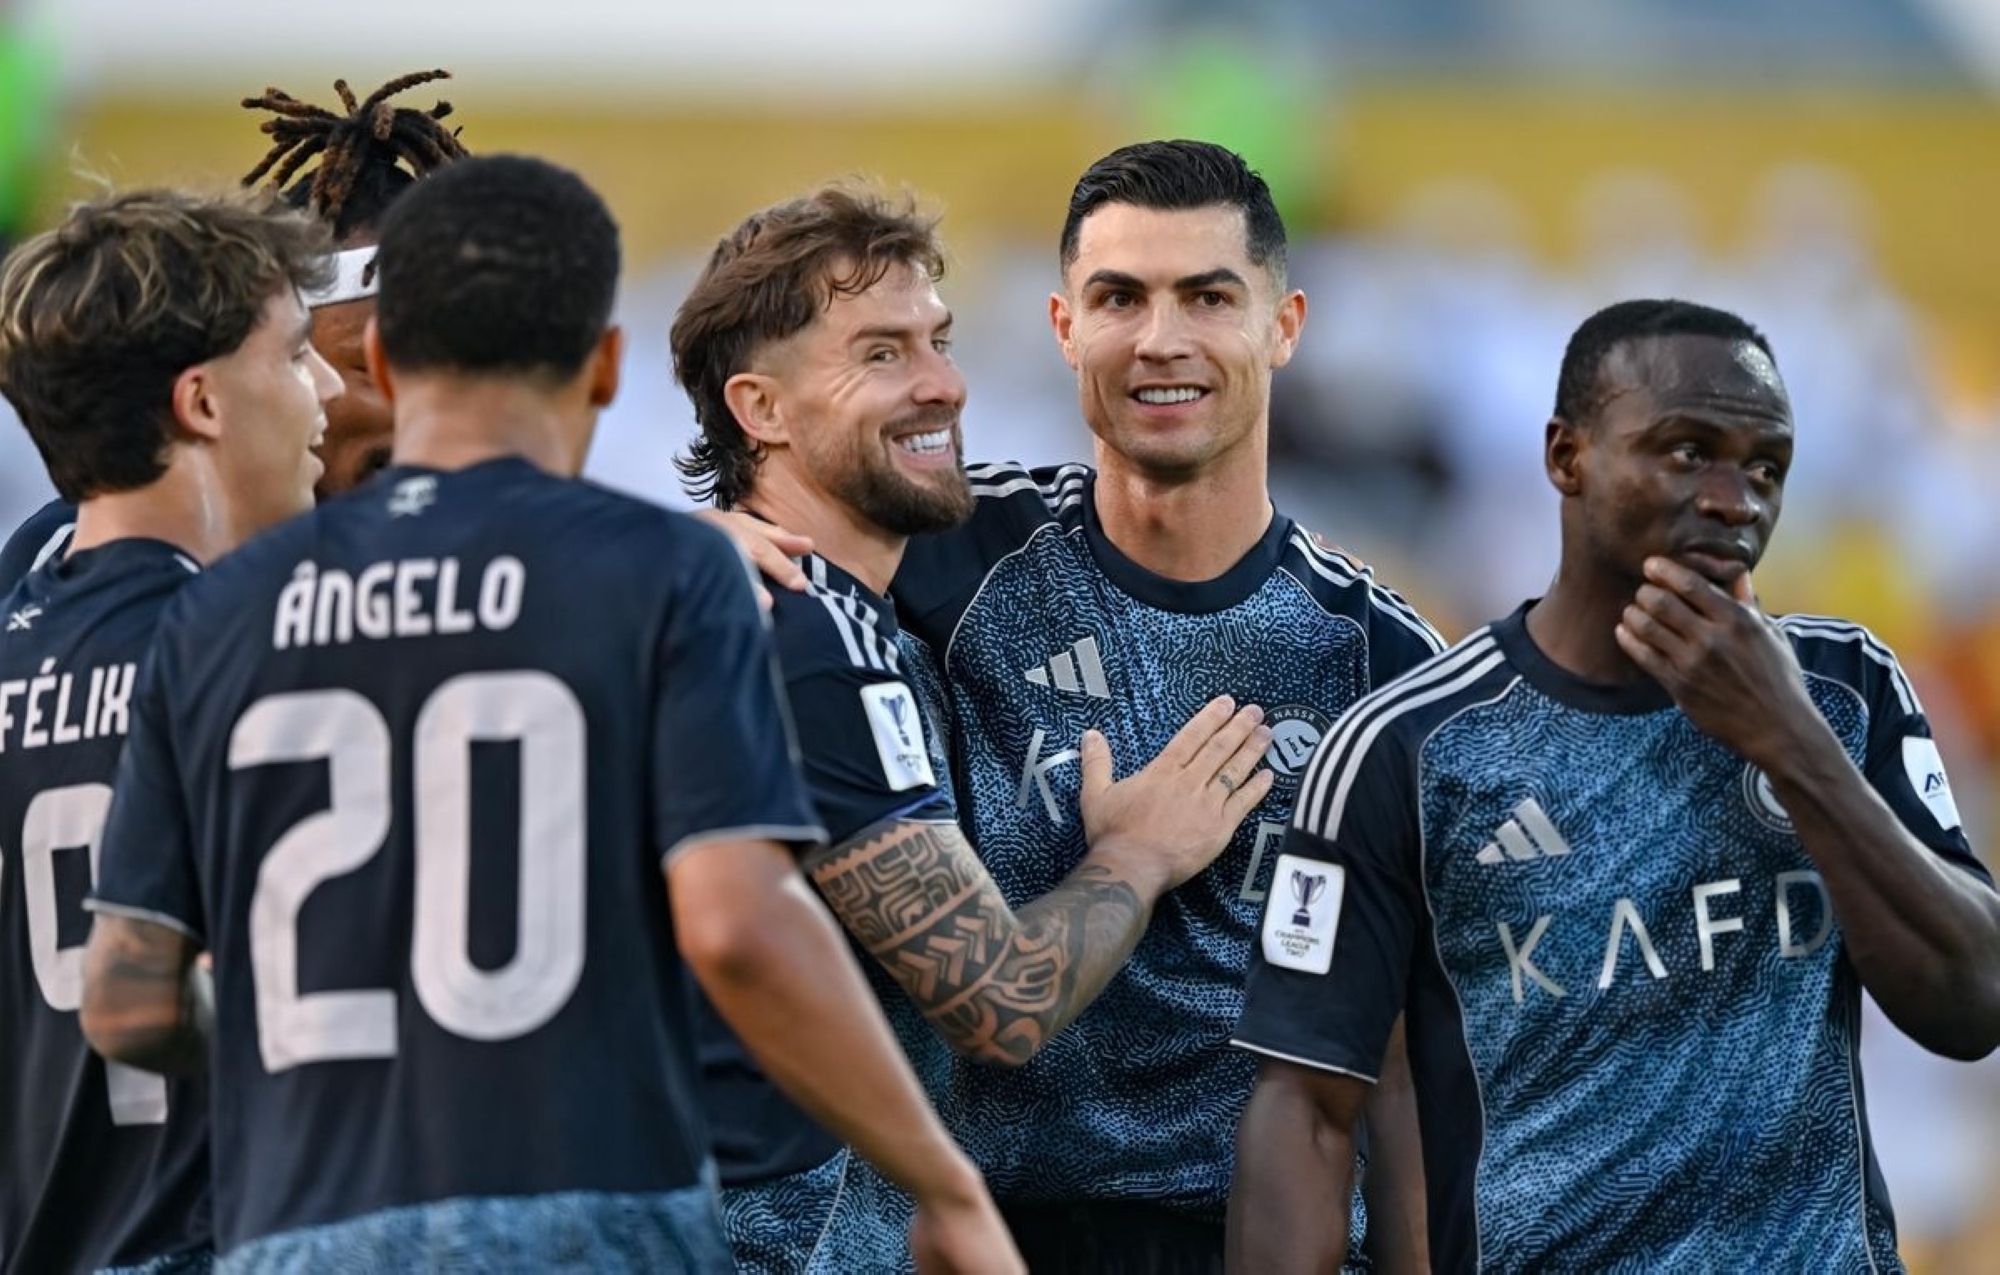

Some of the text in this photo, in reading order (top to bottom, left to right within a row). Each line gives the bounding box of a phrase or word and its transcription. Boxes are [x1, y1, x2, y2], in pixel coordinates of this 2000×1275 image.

[274, 556, 524, 649] ÂNGELO
[0, 657, 137, 749] FÉLIX
[228, 669, 586, 1072] 20
[1497, 870, 1832, 1004] KAFD
